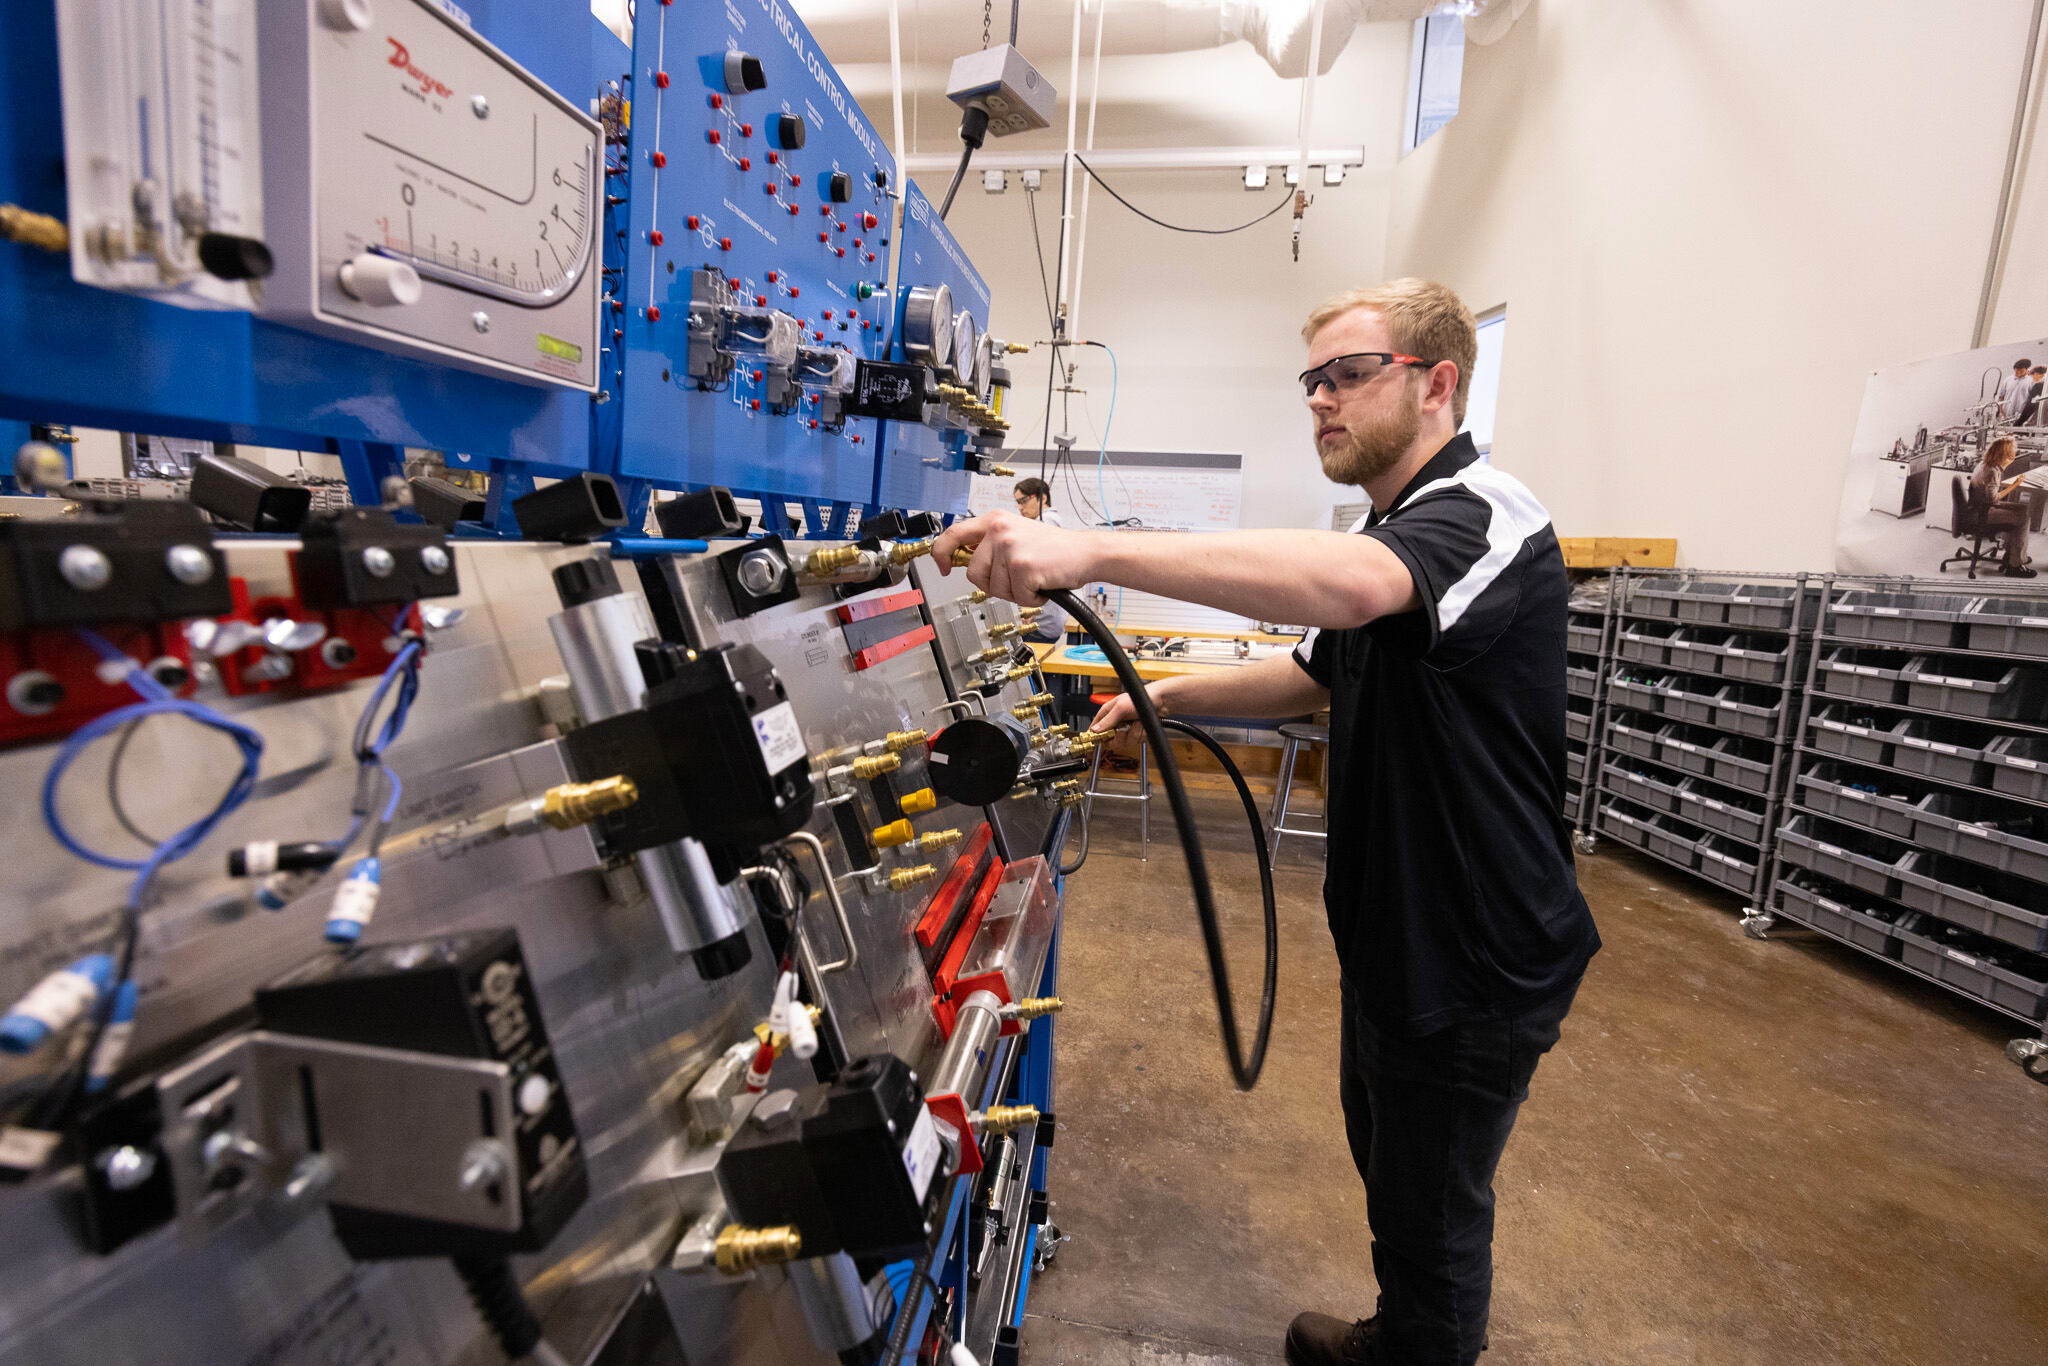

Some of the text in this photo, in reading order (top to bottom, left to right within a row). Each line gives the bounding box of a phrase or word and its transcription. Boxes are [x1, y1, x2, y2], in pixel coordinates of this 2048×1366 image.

[386, 36, 454, 98] Dwyer
[807, 51, 847, 119] CONTROL
[847, 107, 876, 159] MODULE
[552, 167, 562, 187] 6
[401, 182, 415, 207] 0
[551, 203, 559, 222] 4
[539, 220, 548, 241] 2
[534, 248, 541, 268] 1
